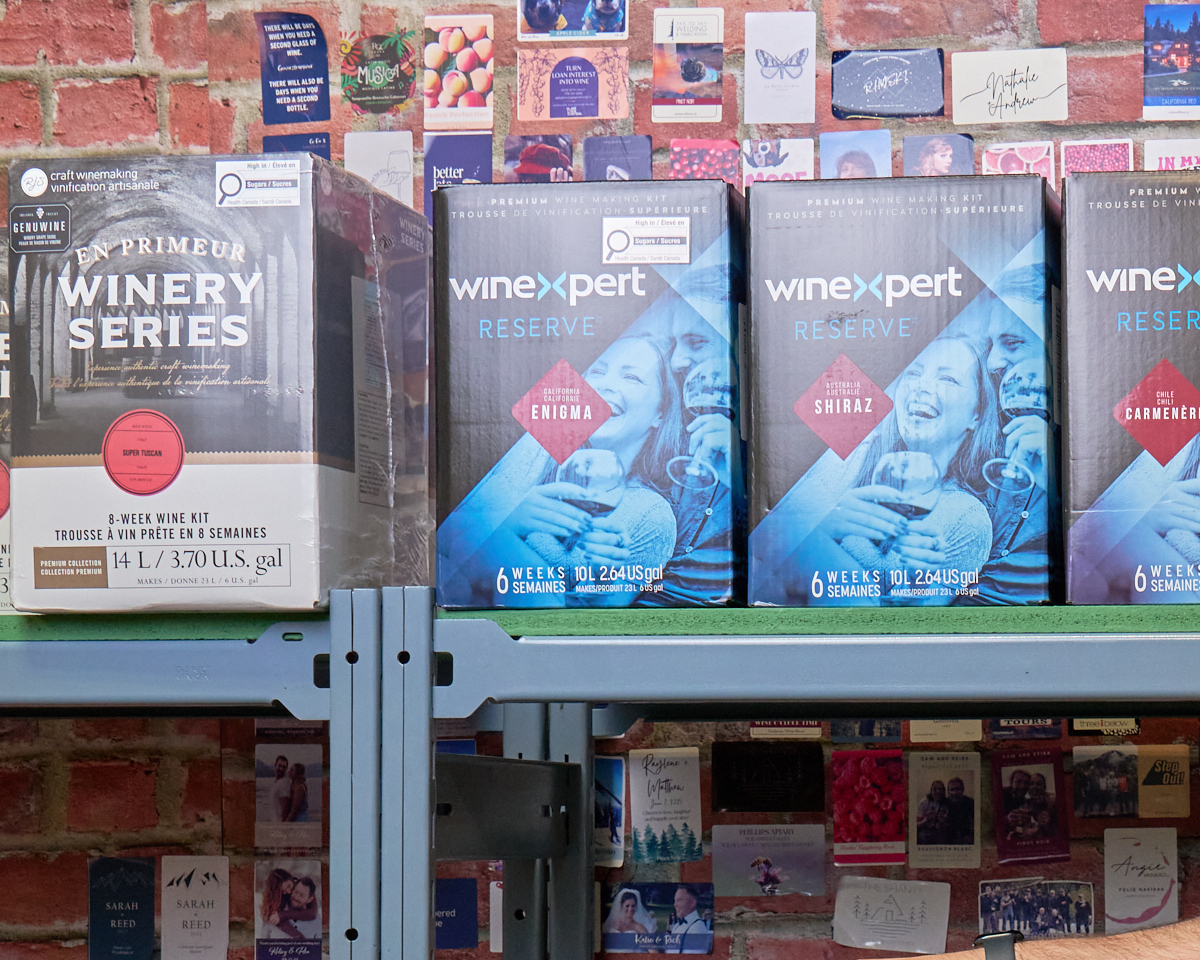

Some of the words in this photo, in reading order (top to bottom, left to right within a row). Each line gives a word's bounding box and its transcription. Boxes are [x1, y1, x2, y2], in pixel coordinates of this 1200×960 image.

[264, 24, 281, 32] THERE
[270, 41, 291, 49] SECOND
[1158, 157, 1175, 170] IN
[50, 171, 74, 182] craft
[76, 169, 138, 182] winemaking
[433, 166, 464, 179] better
[50, 182, 106, 193] vinification
[108, 180, 160, 192] artisanale
[13, 220, 66, 234] GENUWINE
[75, 242, 110, 266] EN
[122, 236, 246, 263] PRIMEUR
[58, 272, 263, 308] WINERY
[68, 314, 249, 350] SERIES
[479, 316, 595, 339] RESERVE
[795, 317, 912, 341] RESERVE
[531, 404, 593, 420] ENIGMA
[814, 398, 873, 415] SHIRAZ
[108, 513, 152, 525] 8-WEEK
[156, 513, 186, 524] WINE
[191, 512, 210, 524] KIT
[55, 530, 103, 541] TROUSSE
[108, 527, 114, 540] À
[118, 529, 136, 540] VIN
[141, 527, 175, 540] PRÊTE
[180, 528, 193, 539] EN
[198, 528, 205, 539] 8
[209, 527, 267, 539] SEMAINES
[113, 551, 131, 569] 14
[138, 551, 151, 569] L
[170, 549, 207, 569] 3.70
[212, 549, 250, 568] U.S.
[256, 548, 283, 576] gal
[512, 566, 566, 579] WEEKS
[827, 570, 880, 584] WEEKS
[512, 580, 566, 594] SEMAINES
[827, 584, 881, 598] SEMAINES
[1154, 760, 1179, 774] Step
[1162, 772, 1185, 786] Out!
[106, 902, 139, 911] SARAH
[176, 900, 215, 909] SARAH
[110, 920, 136, 928] REED
[182, 920, 211, 929] REED
